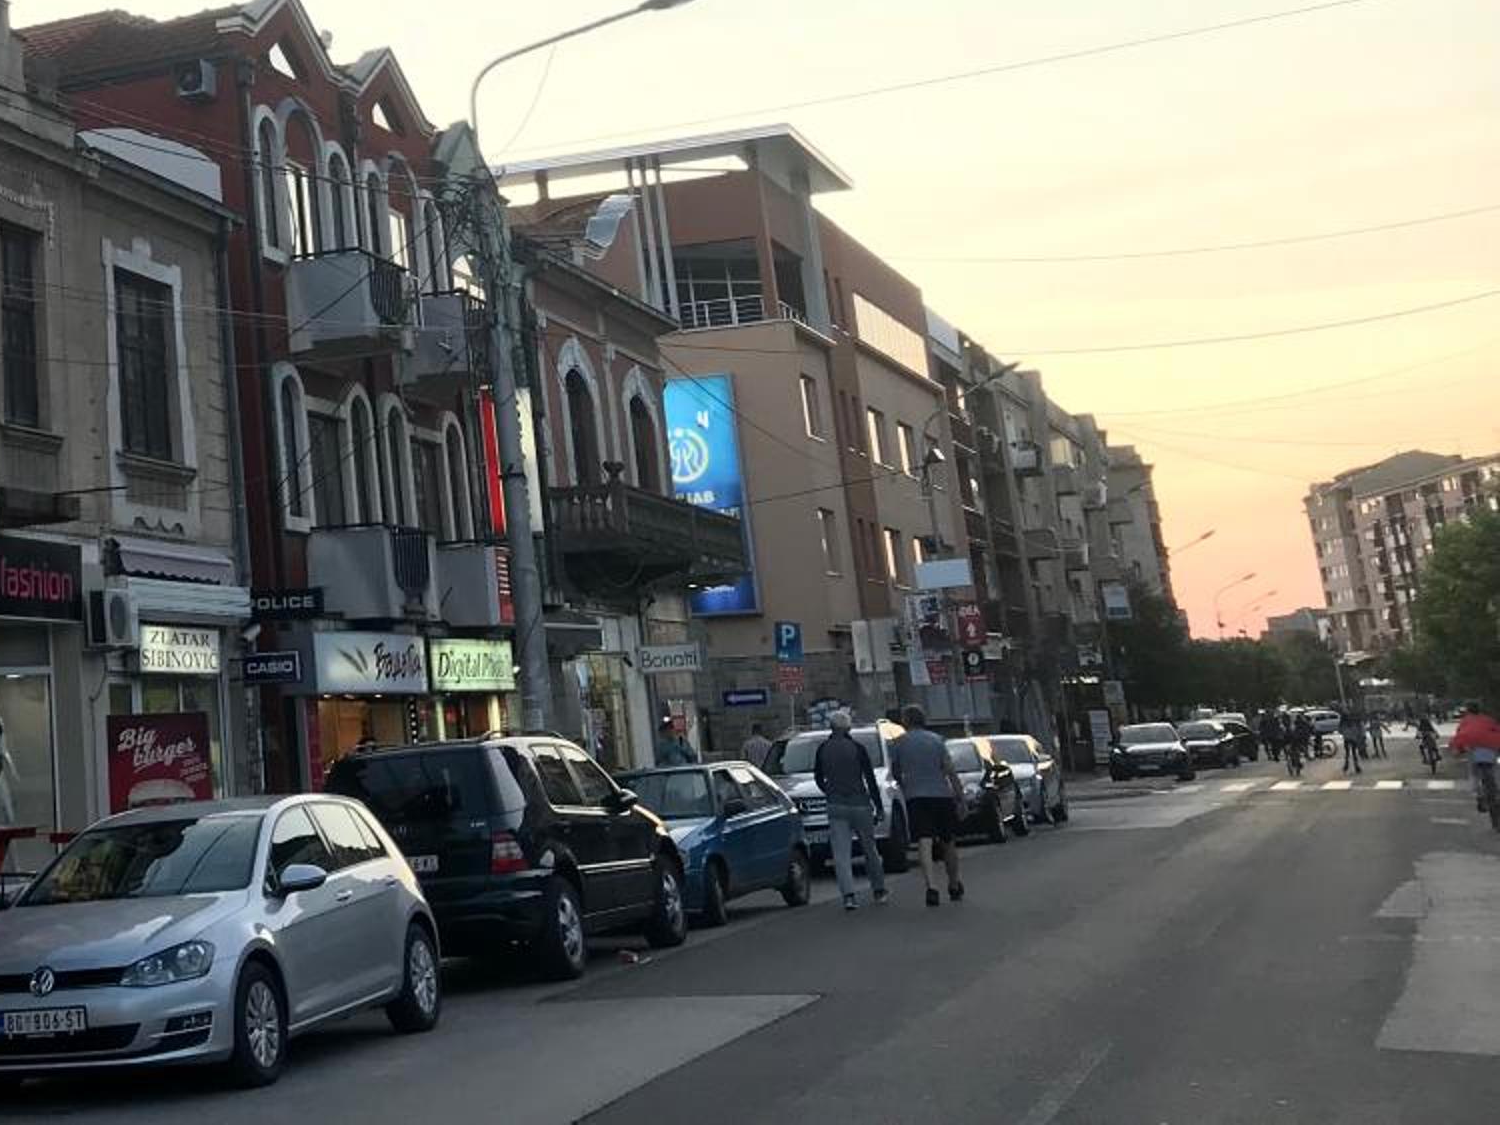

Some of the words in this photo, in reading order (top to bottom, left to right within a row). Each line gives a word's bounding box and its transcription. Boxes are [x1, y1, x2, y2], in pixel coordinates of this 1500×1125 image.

[0, 558, 73, 603] fashion
[250, 595, 315, 610] OLICE
[148, 630, 211, 648] ZLATAR
[781, 624, 796, 648] P
[246, 660, 293, 674] CASIO
[438, 650, 481, 683] Digital
[117, 726, 157, 752] Big
